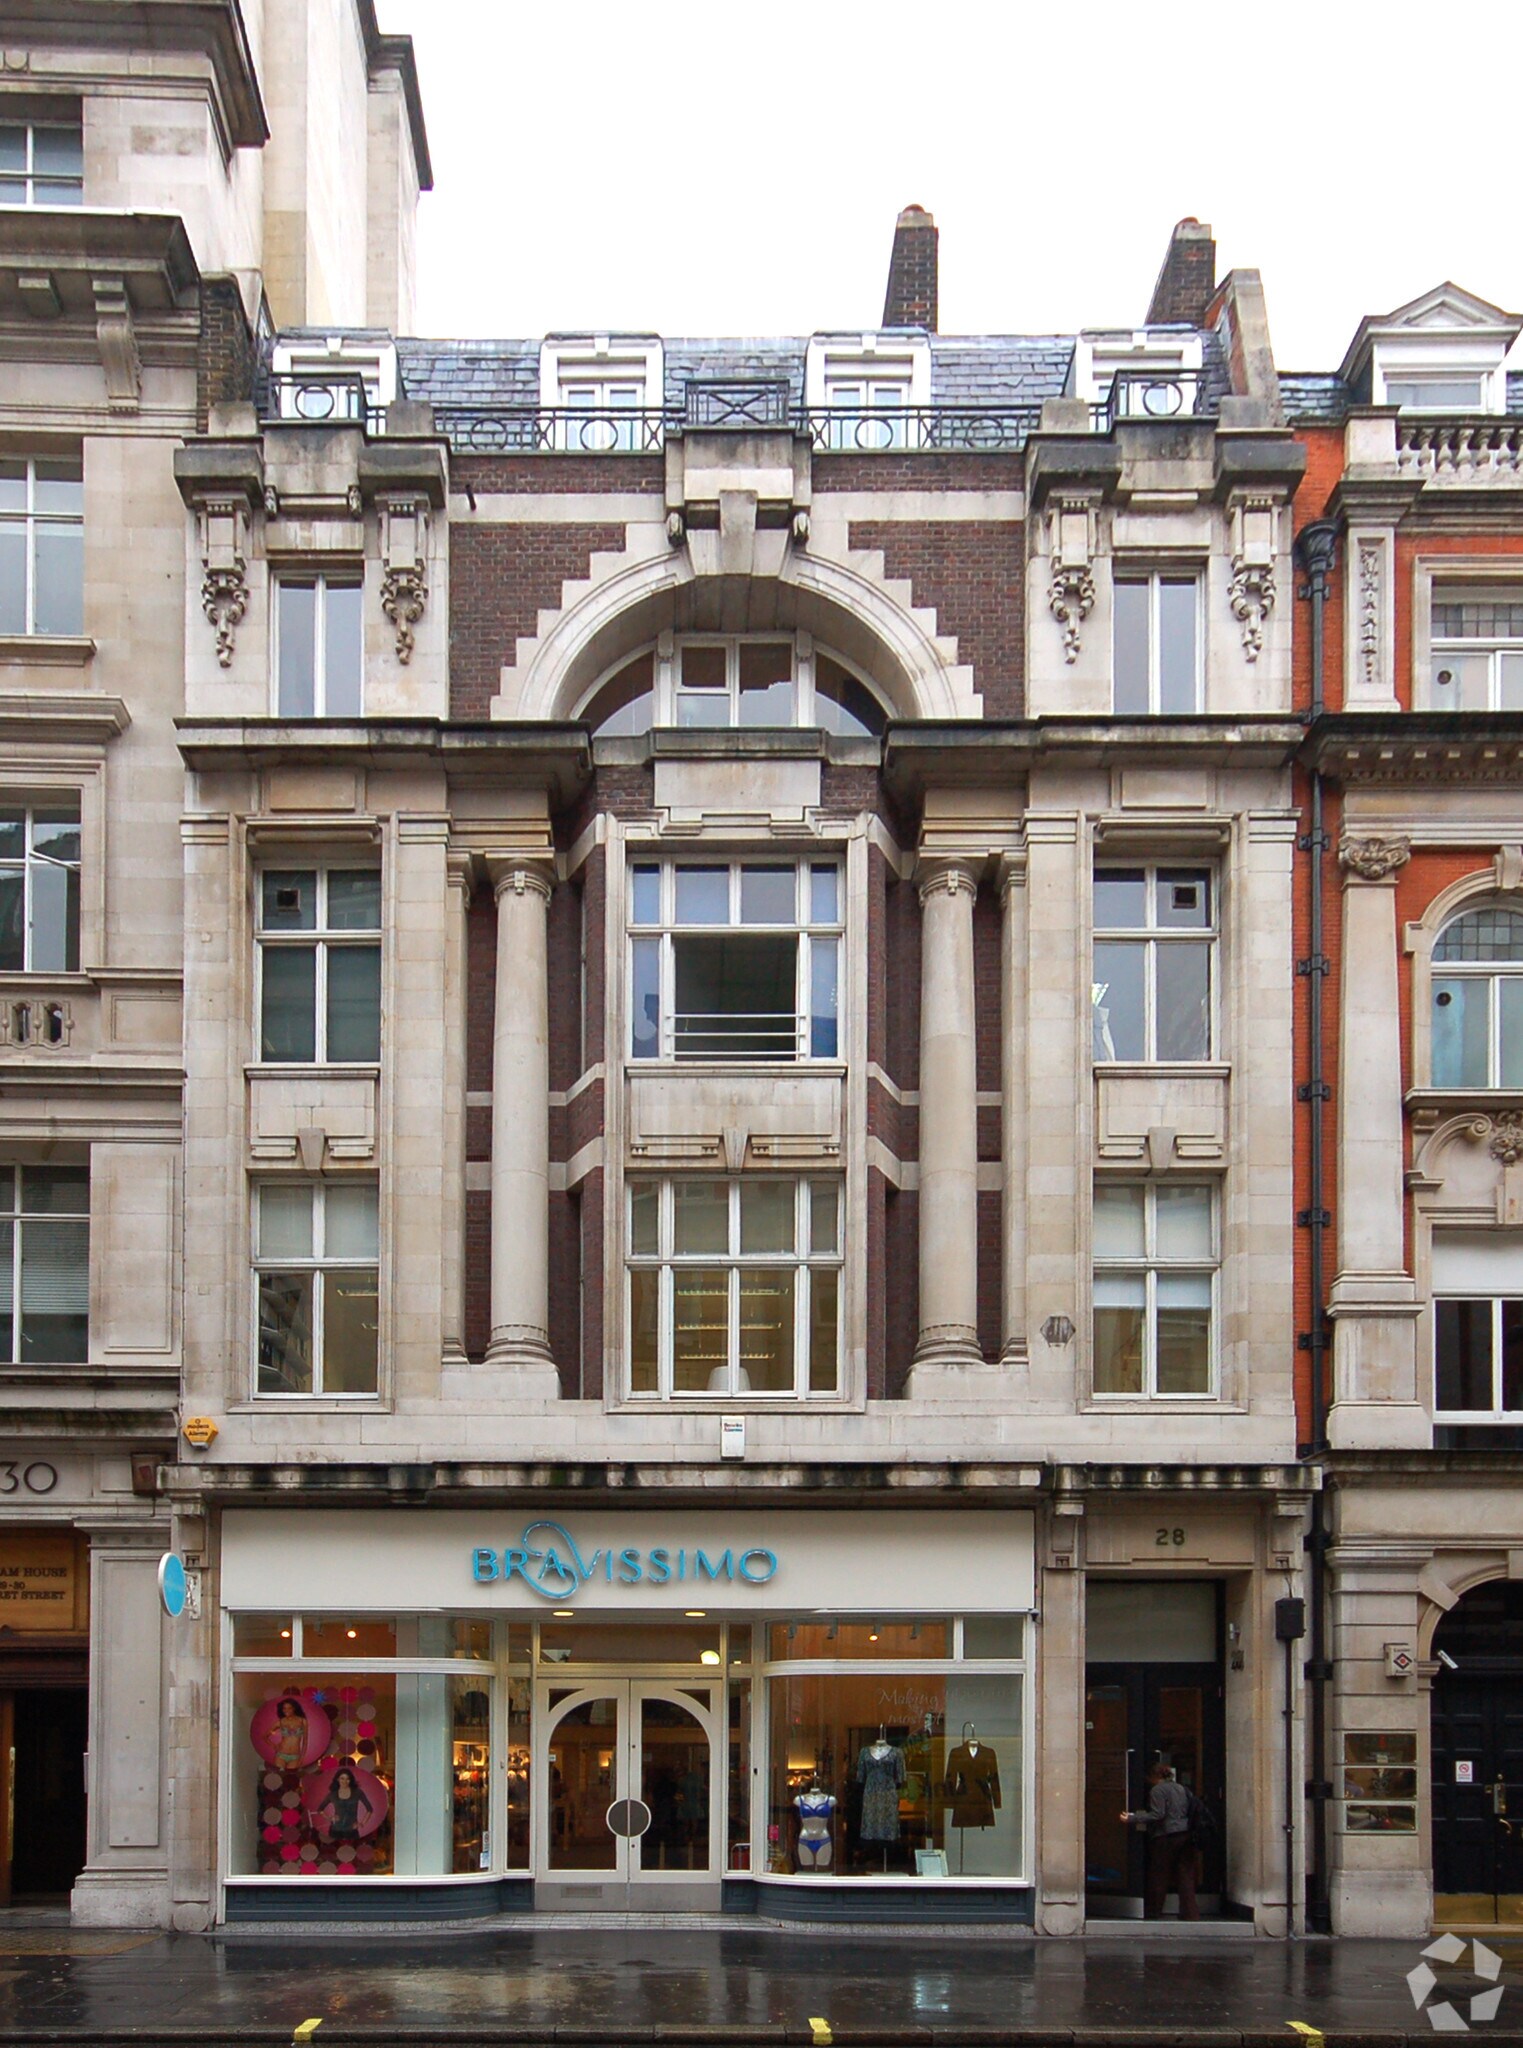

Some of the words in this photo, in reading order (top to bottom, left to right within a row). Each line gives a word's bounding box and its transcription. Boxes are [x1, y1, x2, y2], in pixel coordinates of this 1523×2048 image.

[0, 1461, 58, 1495] 30
[1156, 1528, 1185, 1546] 28
[473, 1520, 778, 1599] BRAVISSIMO
[23, 1567, 67, 1577] HOUSE
[21, 1591, 66, 1600] STREET
